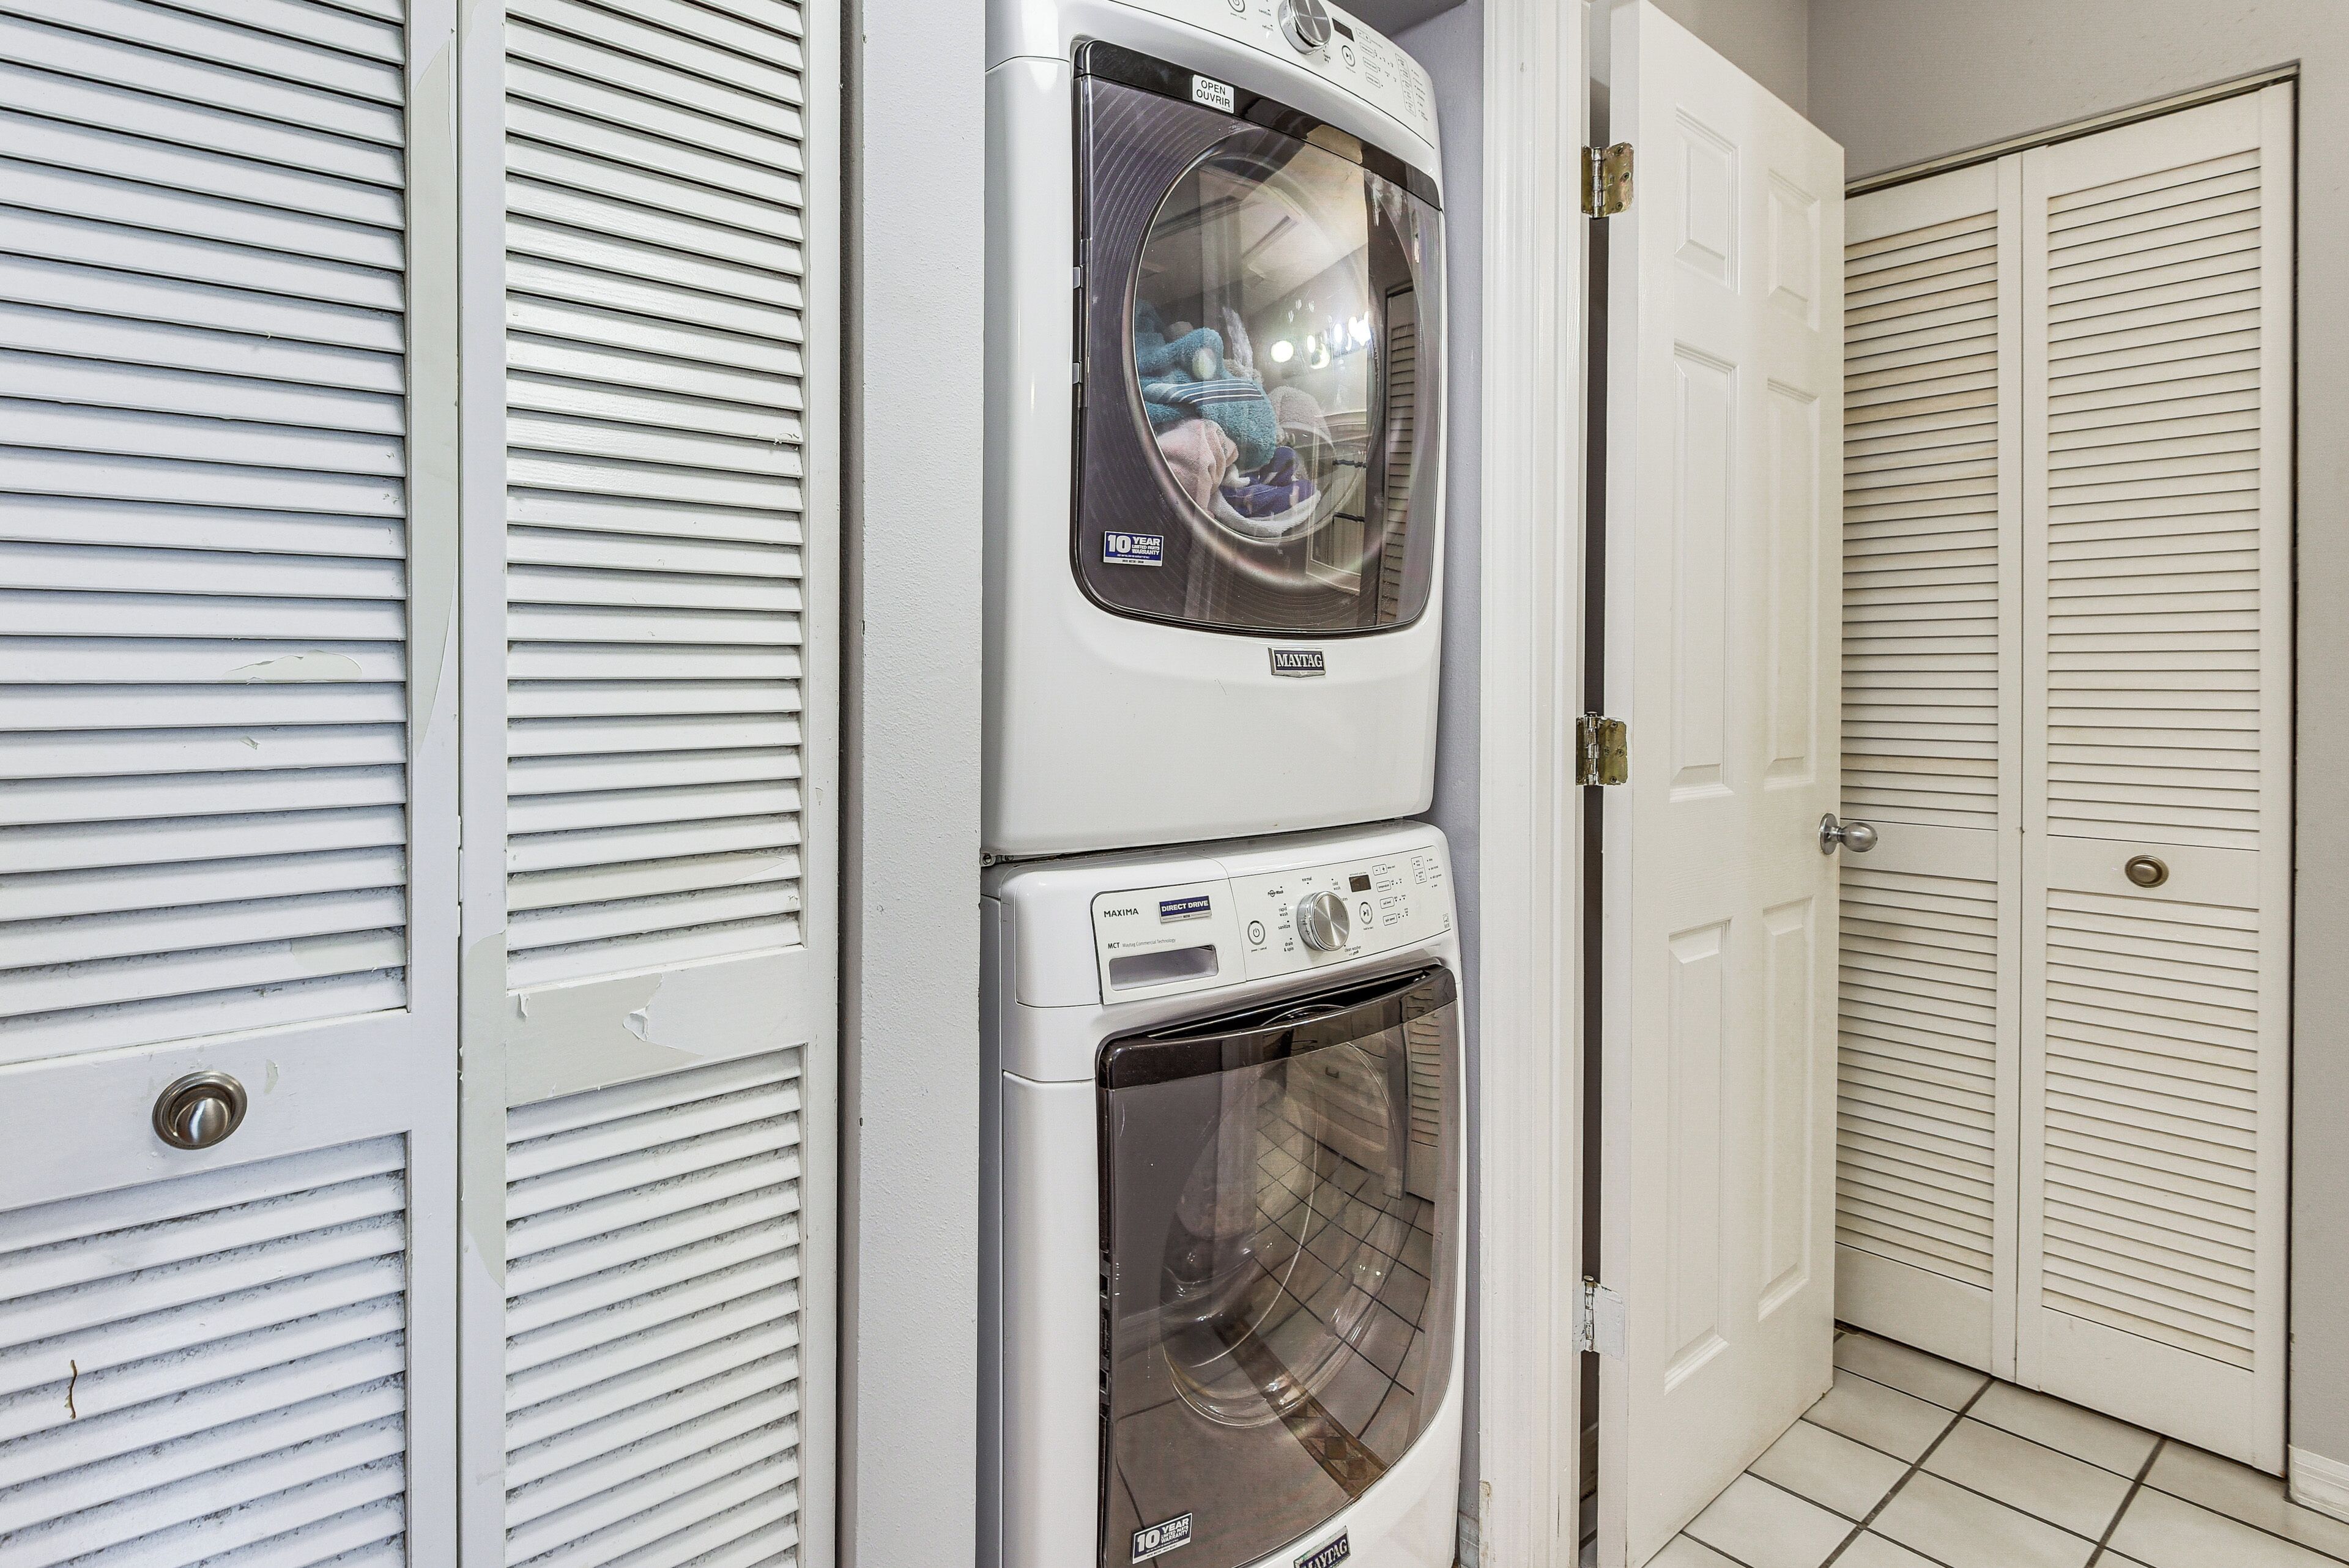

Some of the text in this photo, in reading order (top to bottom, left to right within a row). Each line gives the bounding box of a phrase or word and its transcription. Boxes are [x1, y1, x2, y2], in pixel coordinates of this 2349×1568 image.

[1201, 80, 1225, 95] OPEN
[1197, 89, 1230, 108] OUVRIR
[1108, 535, 1160, 553] 10 YEAR
[1275, 654, 1323, 667] MAYTAG
[1104, 908, 1139, 918] MAXIMA
[1161, 903, 1187, 912] DIRECT
[1138, 1529, 1160, 1552] 10
[1162, 1518, 1189, 1533] YEAR
[1161, 1531, 1176, 1539] LIMITED
[1161, 1530, 1189, 1544] WARRANTY
